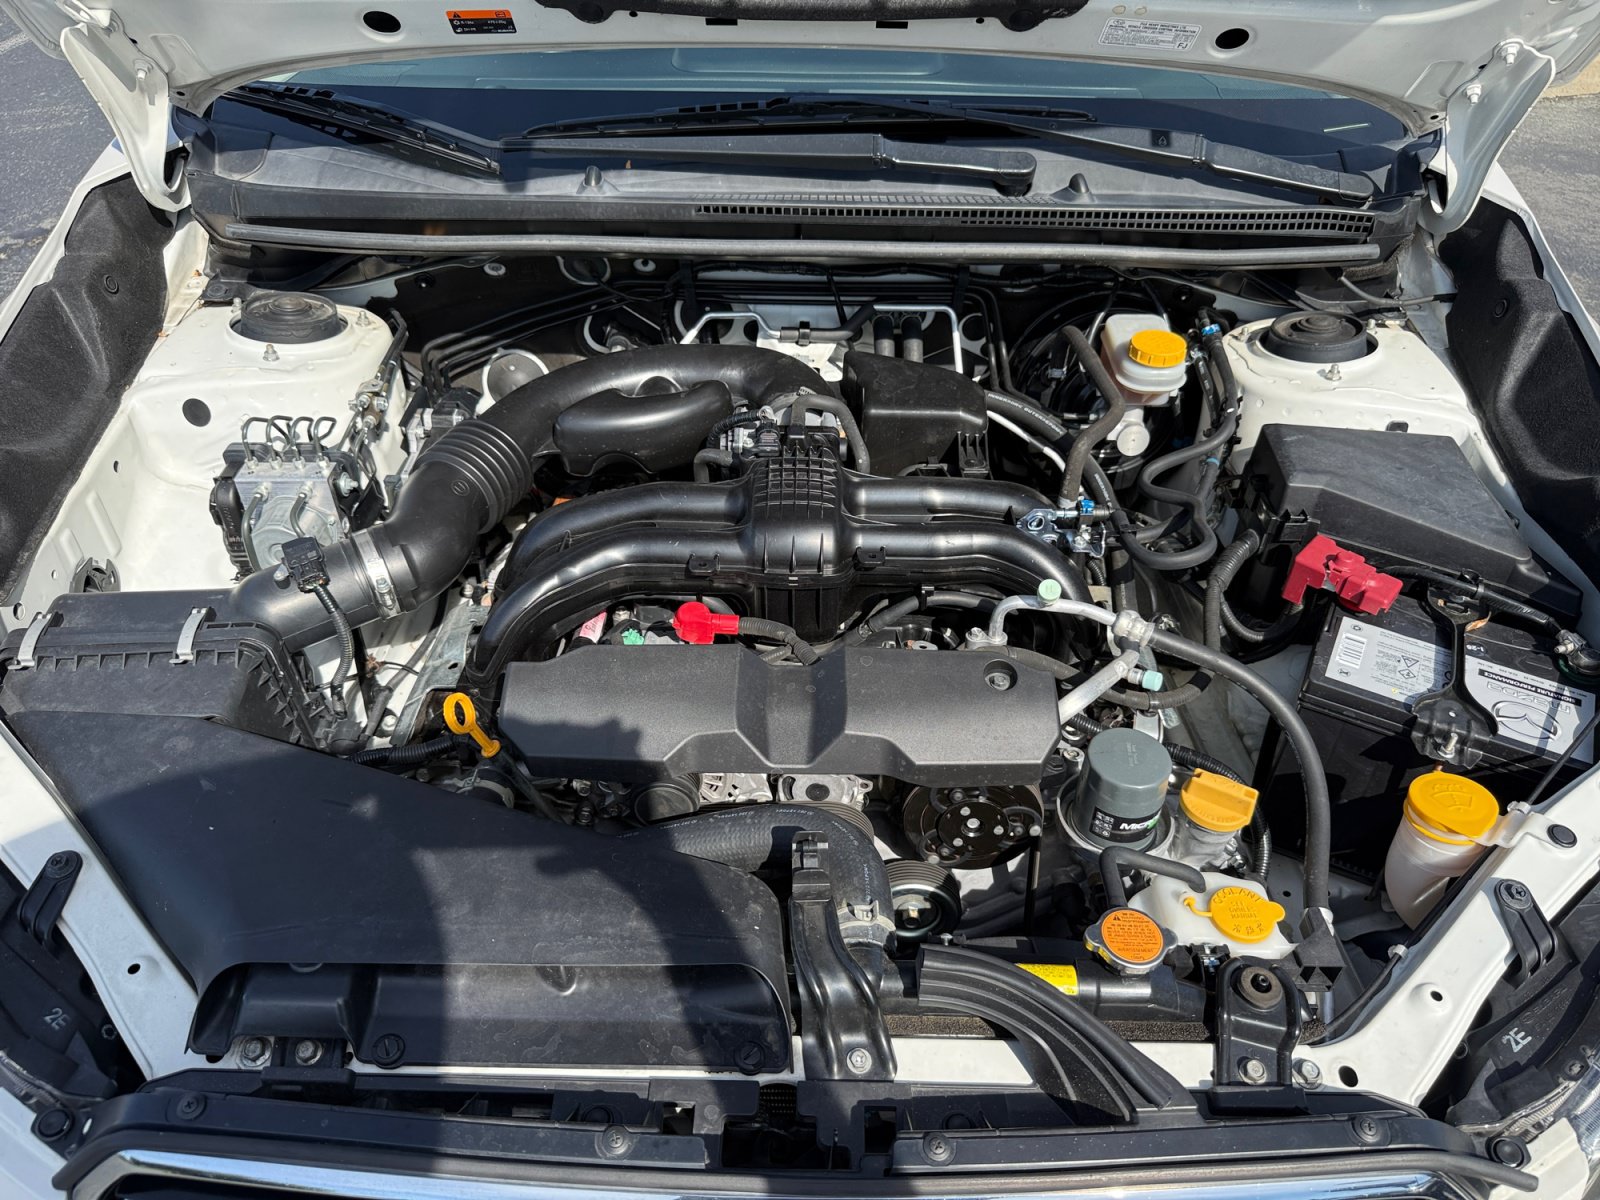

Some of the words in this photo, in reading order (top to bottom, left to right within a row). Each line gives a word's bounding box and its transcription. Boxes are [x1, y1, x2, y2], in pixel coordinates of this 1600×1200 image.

[1483, 671, 1536, 692] PERFORMANCE
[1536, 687, 1576, 703] SIGNATURE
[1213, 887, 1265, 904] COOLANT
[43, 1008, 70, 1031] 2E
[1502, 1027, 1532, 1053] 2E
